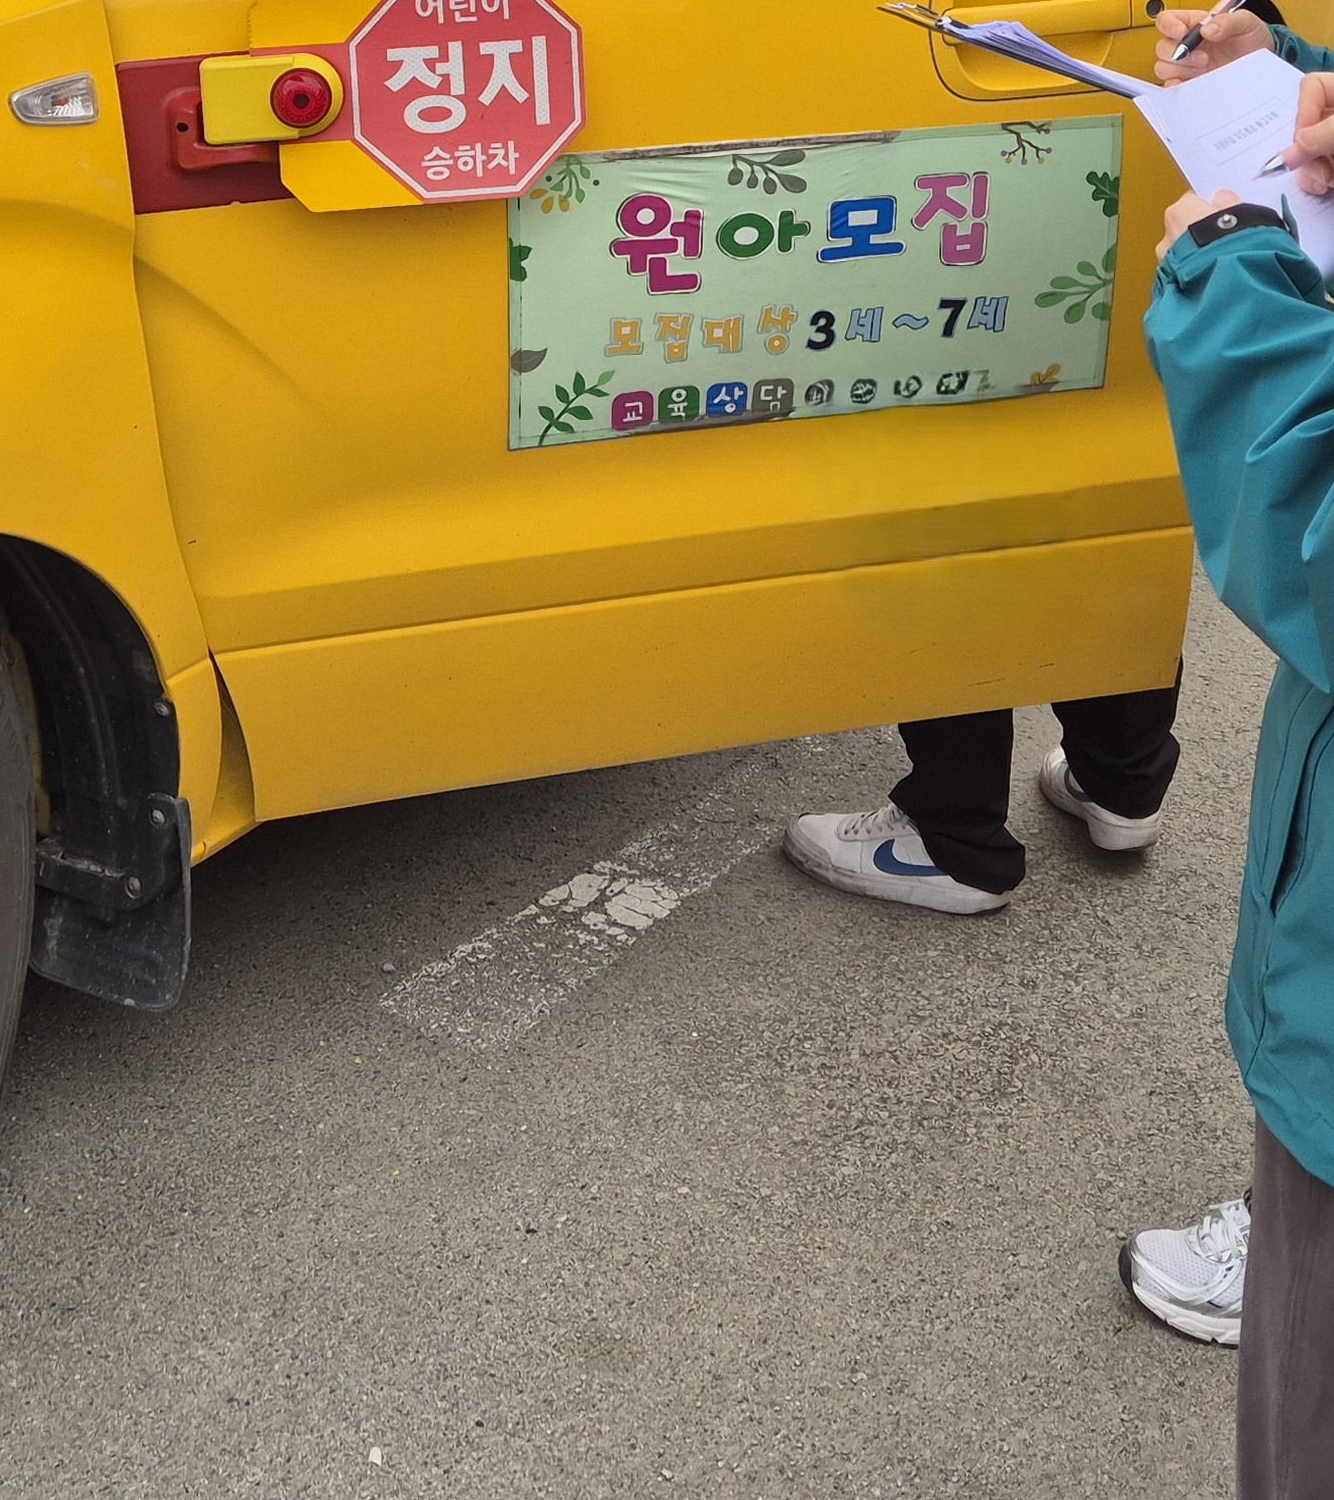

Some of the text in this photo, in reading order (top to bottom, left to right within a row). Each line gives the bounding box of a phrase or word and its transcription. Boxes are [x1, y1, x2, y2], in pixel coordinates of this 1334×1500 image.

[384, 35, 551, 134] 정지
[421, 140, 519, 181] 승하차
[609, 171, 990, 295] 원아모집
[604, 304, 798, 363] 모집대상
[620, 382, 788, 424] 교육상담
